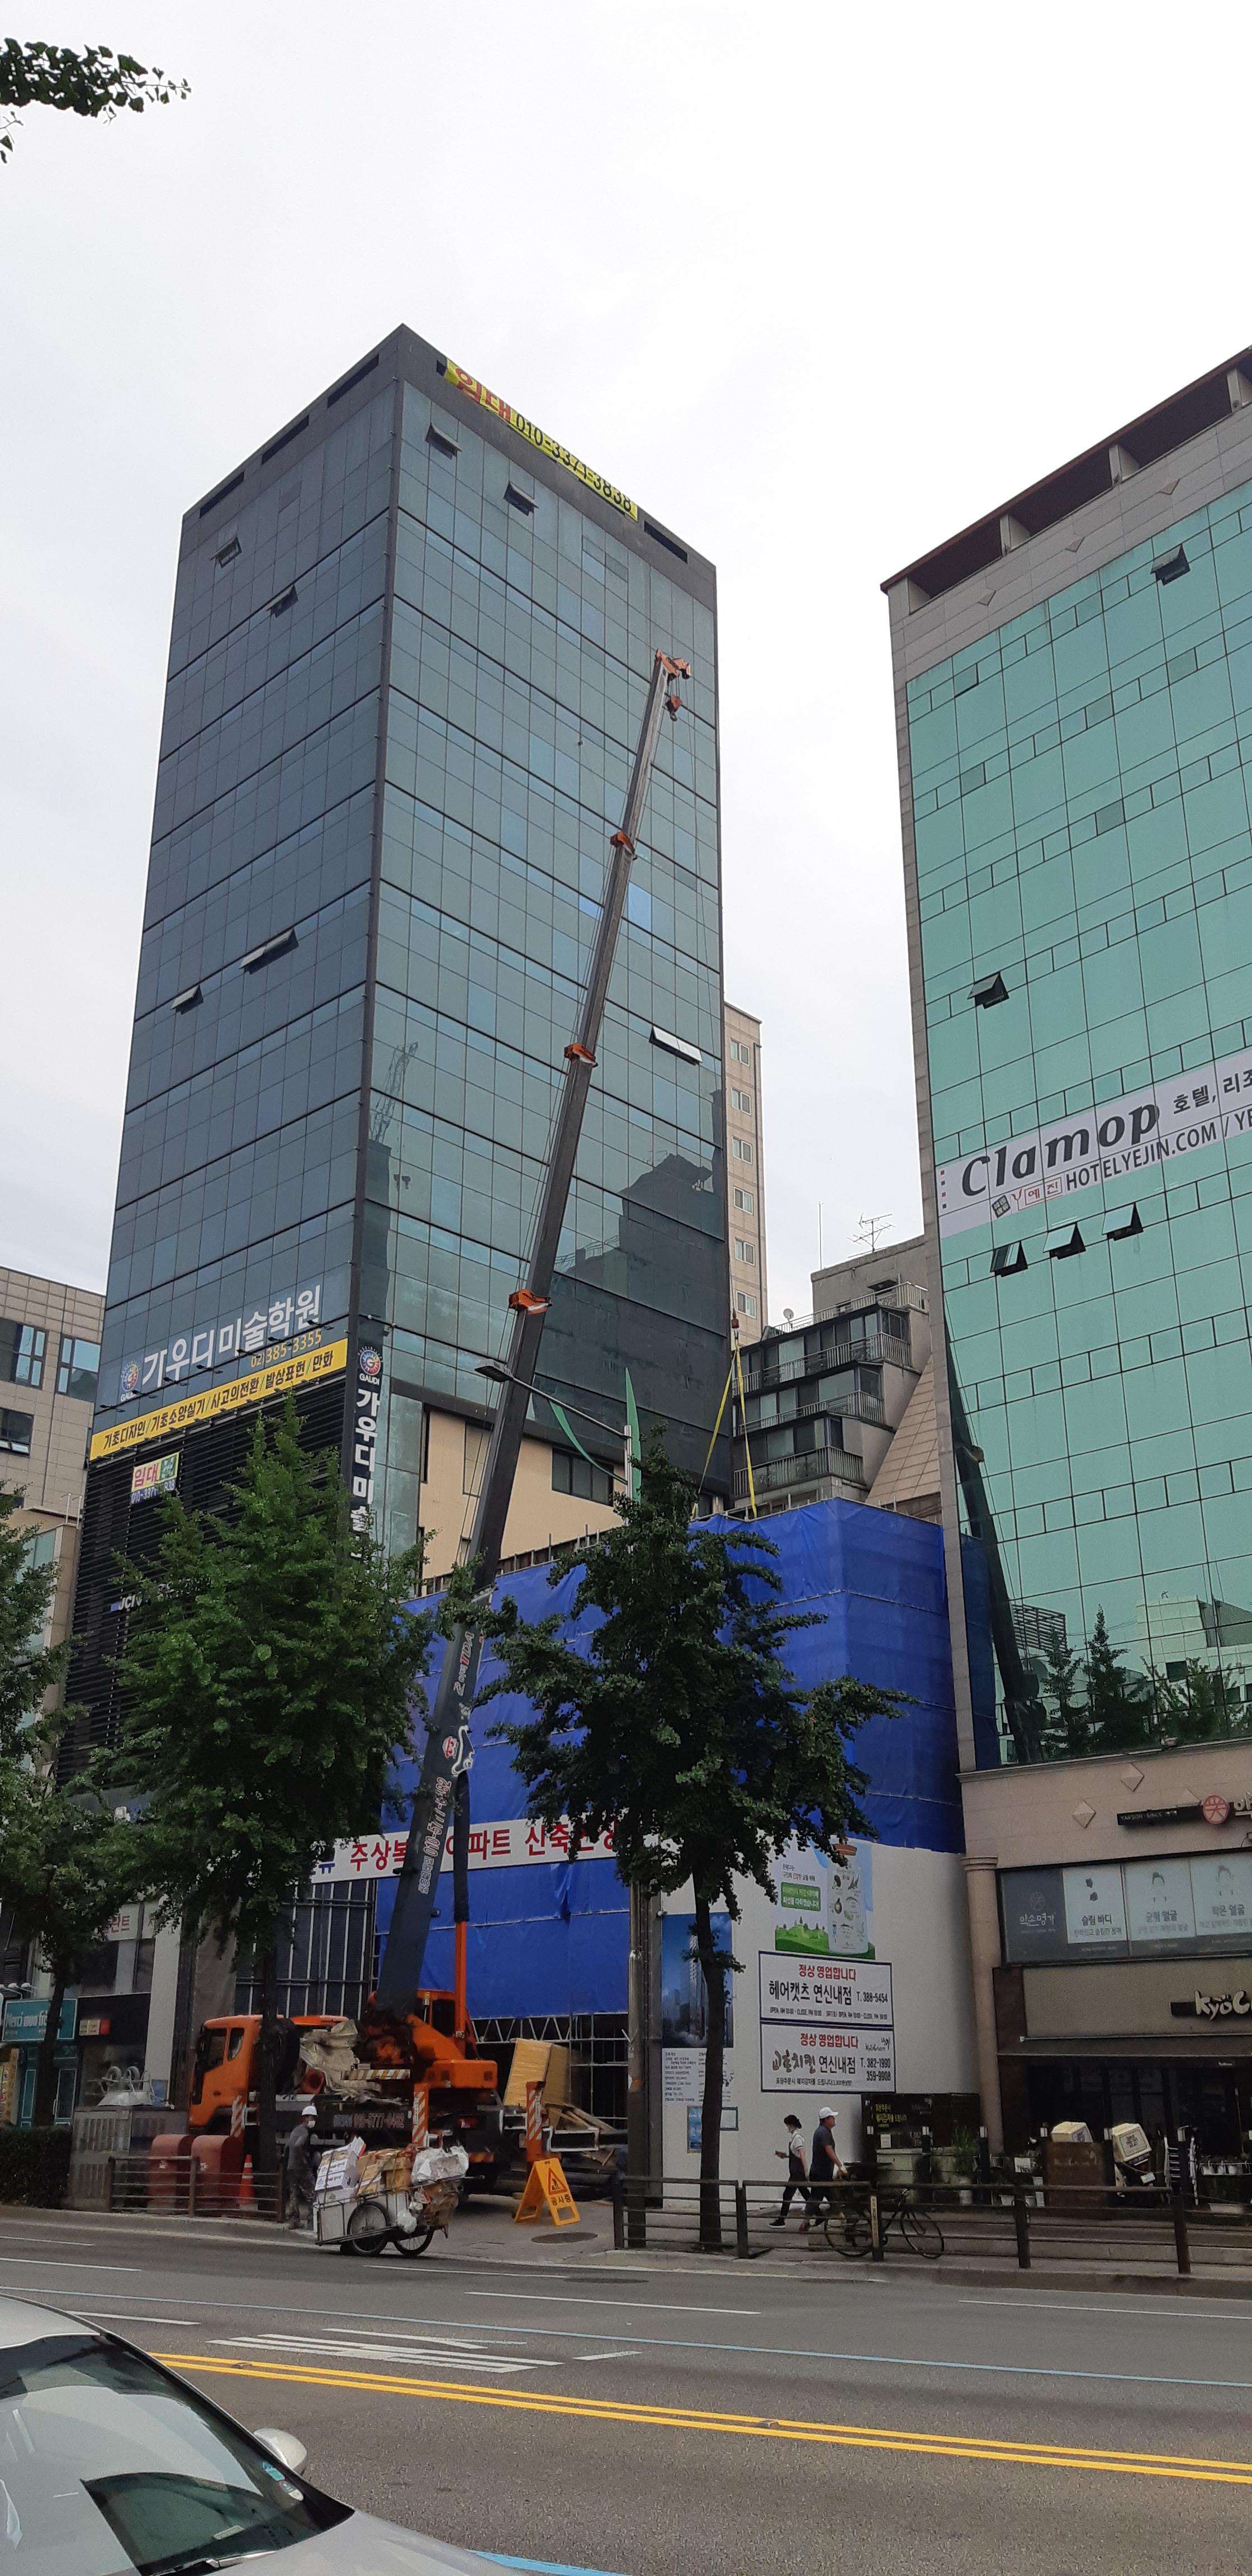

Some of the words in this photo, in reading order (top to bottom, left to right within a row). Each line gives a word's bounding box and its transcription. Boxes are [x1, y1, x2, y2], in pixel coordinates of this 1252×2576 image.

[456, 368, 511, 422] 임대
[516, 413, 633, 513] 010-3371-3838
[961, 1103, 1160, 1197] Clamop
[1066, 1121, 1217, 1191] HOTELYEJIN.COM
[142, 1284, 321, 1388] 가우디미술학원
[359, 1372, 380, 1385] GAUDI
[134, 1462, 159, 1488] 임대
[350, 1839, 409, 1872] 주상복
[1082, 1914, 1096, 1926] 슬림
[1098, 1914, 1112, 1925] 바디
[798, 1964, 815, 1978] 정상
[817, 1966, 856, 1981] 영업합니다
[813, 1983, 852, 2005] 연신내점
[800, 2033, 817, 2047] 정상
[818, 2034, 859, 2048] 영업합니다
[818, 2055, 856, 2074] 연신내점
[550, 2194, 571, 2206] 공사중
